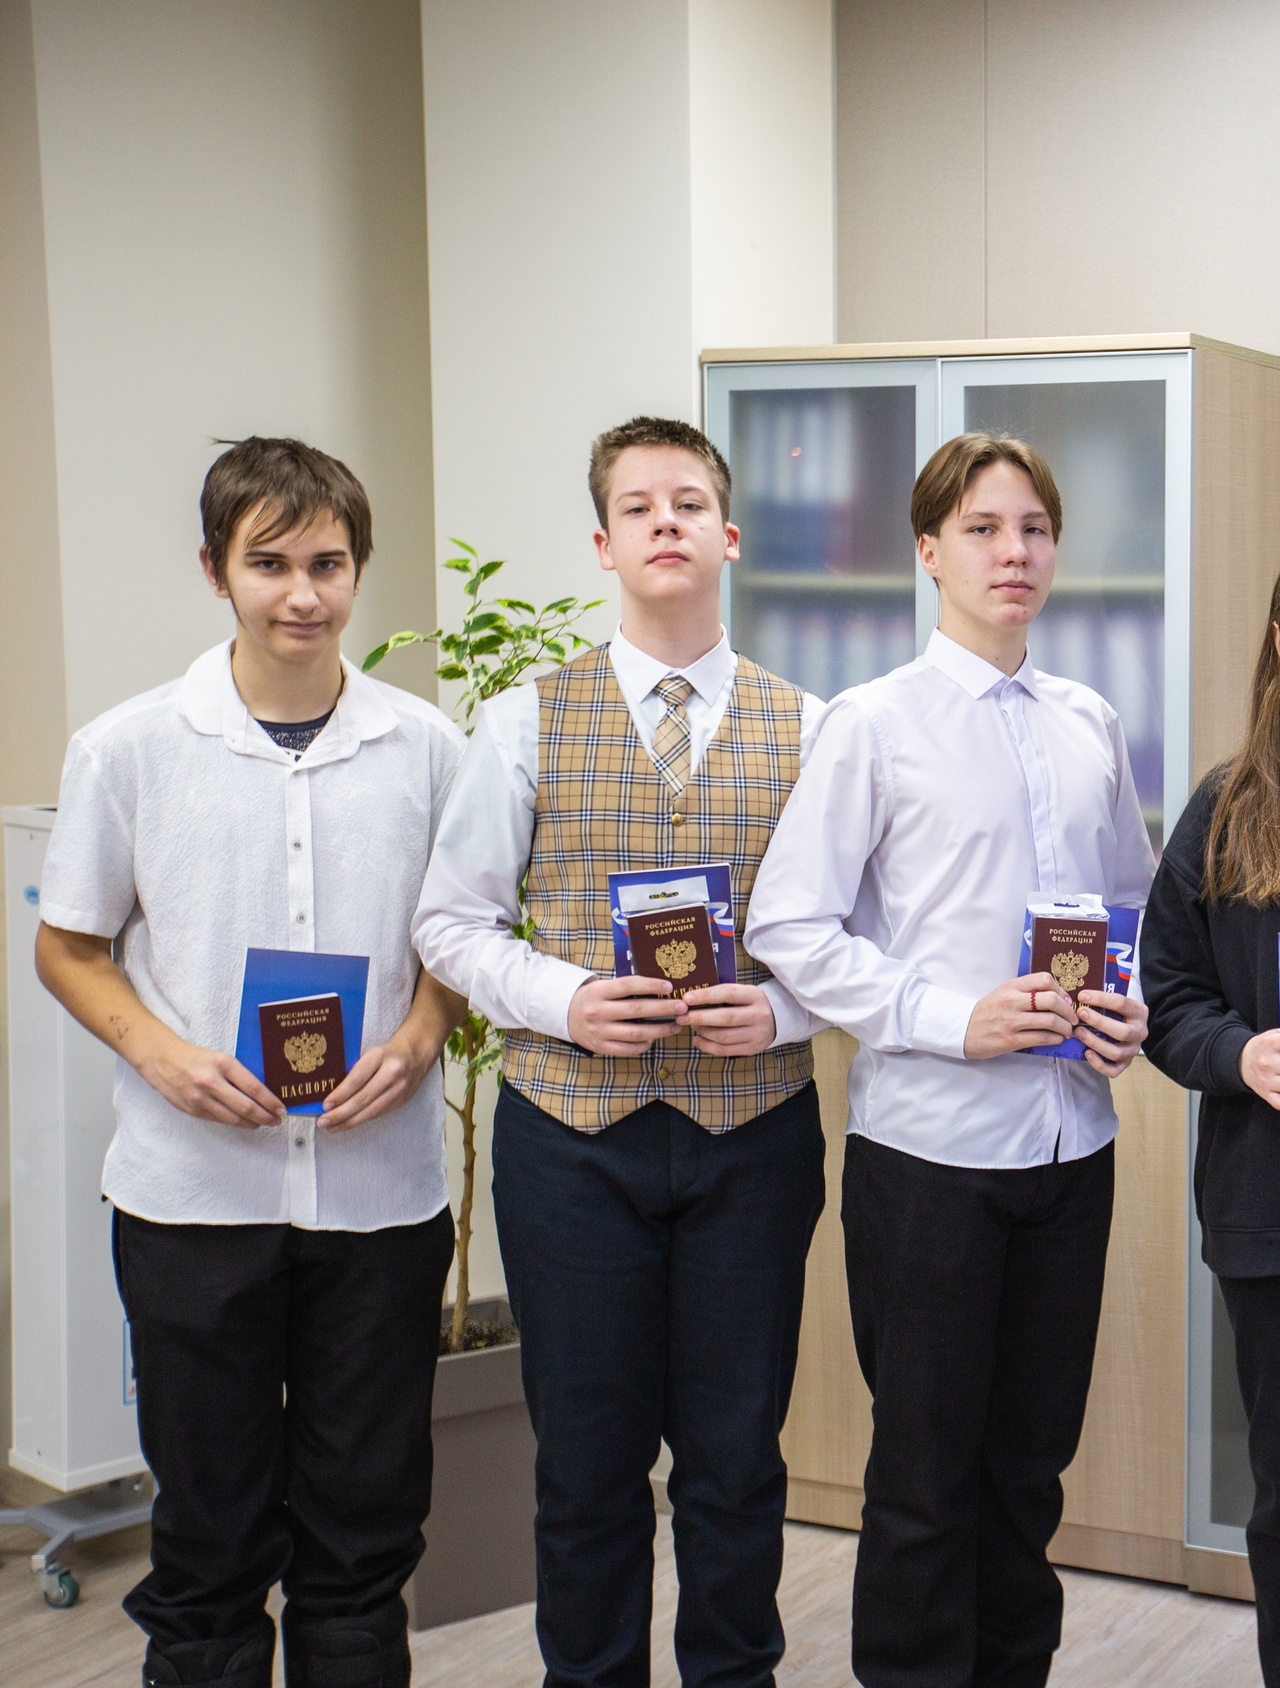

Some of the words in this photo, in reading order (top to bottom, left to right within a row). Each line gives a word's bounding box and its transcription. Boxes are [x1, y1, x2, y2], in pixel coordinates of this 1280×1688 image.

[645, 916, 696, 931] РОССИЙСКАЯ
[649, 923, 694, 936] ФЕДЕРАЦИЯ
[1049, 928, 1097, 937] РОССИЙСКАЯ
[1052, 936, 1093, 944] ФЕДЕРАЦИЯ
[276, 1007, 329, 1021] РОССИЙСКАЯ
[280, 1015, 327, 1027] ФЕДЕРАЦИЯ
[281, 1078, 336, 1099] ПАСПОРТ
